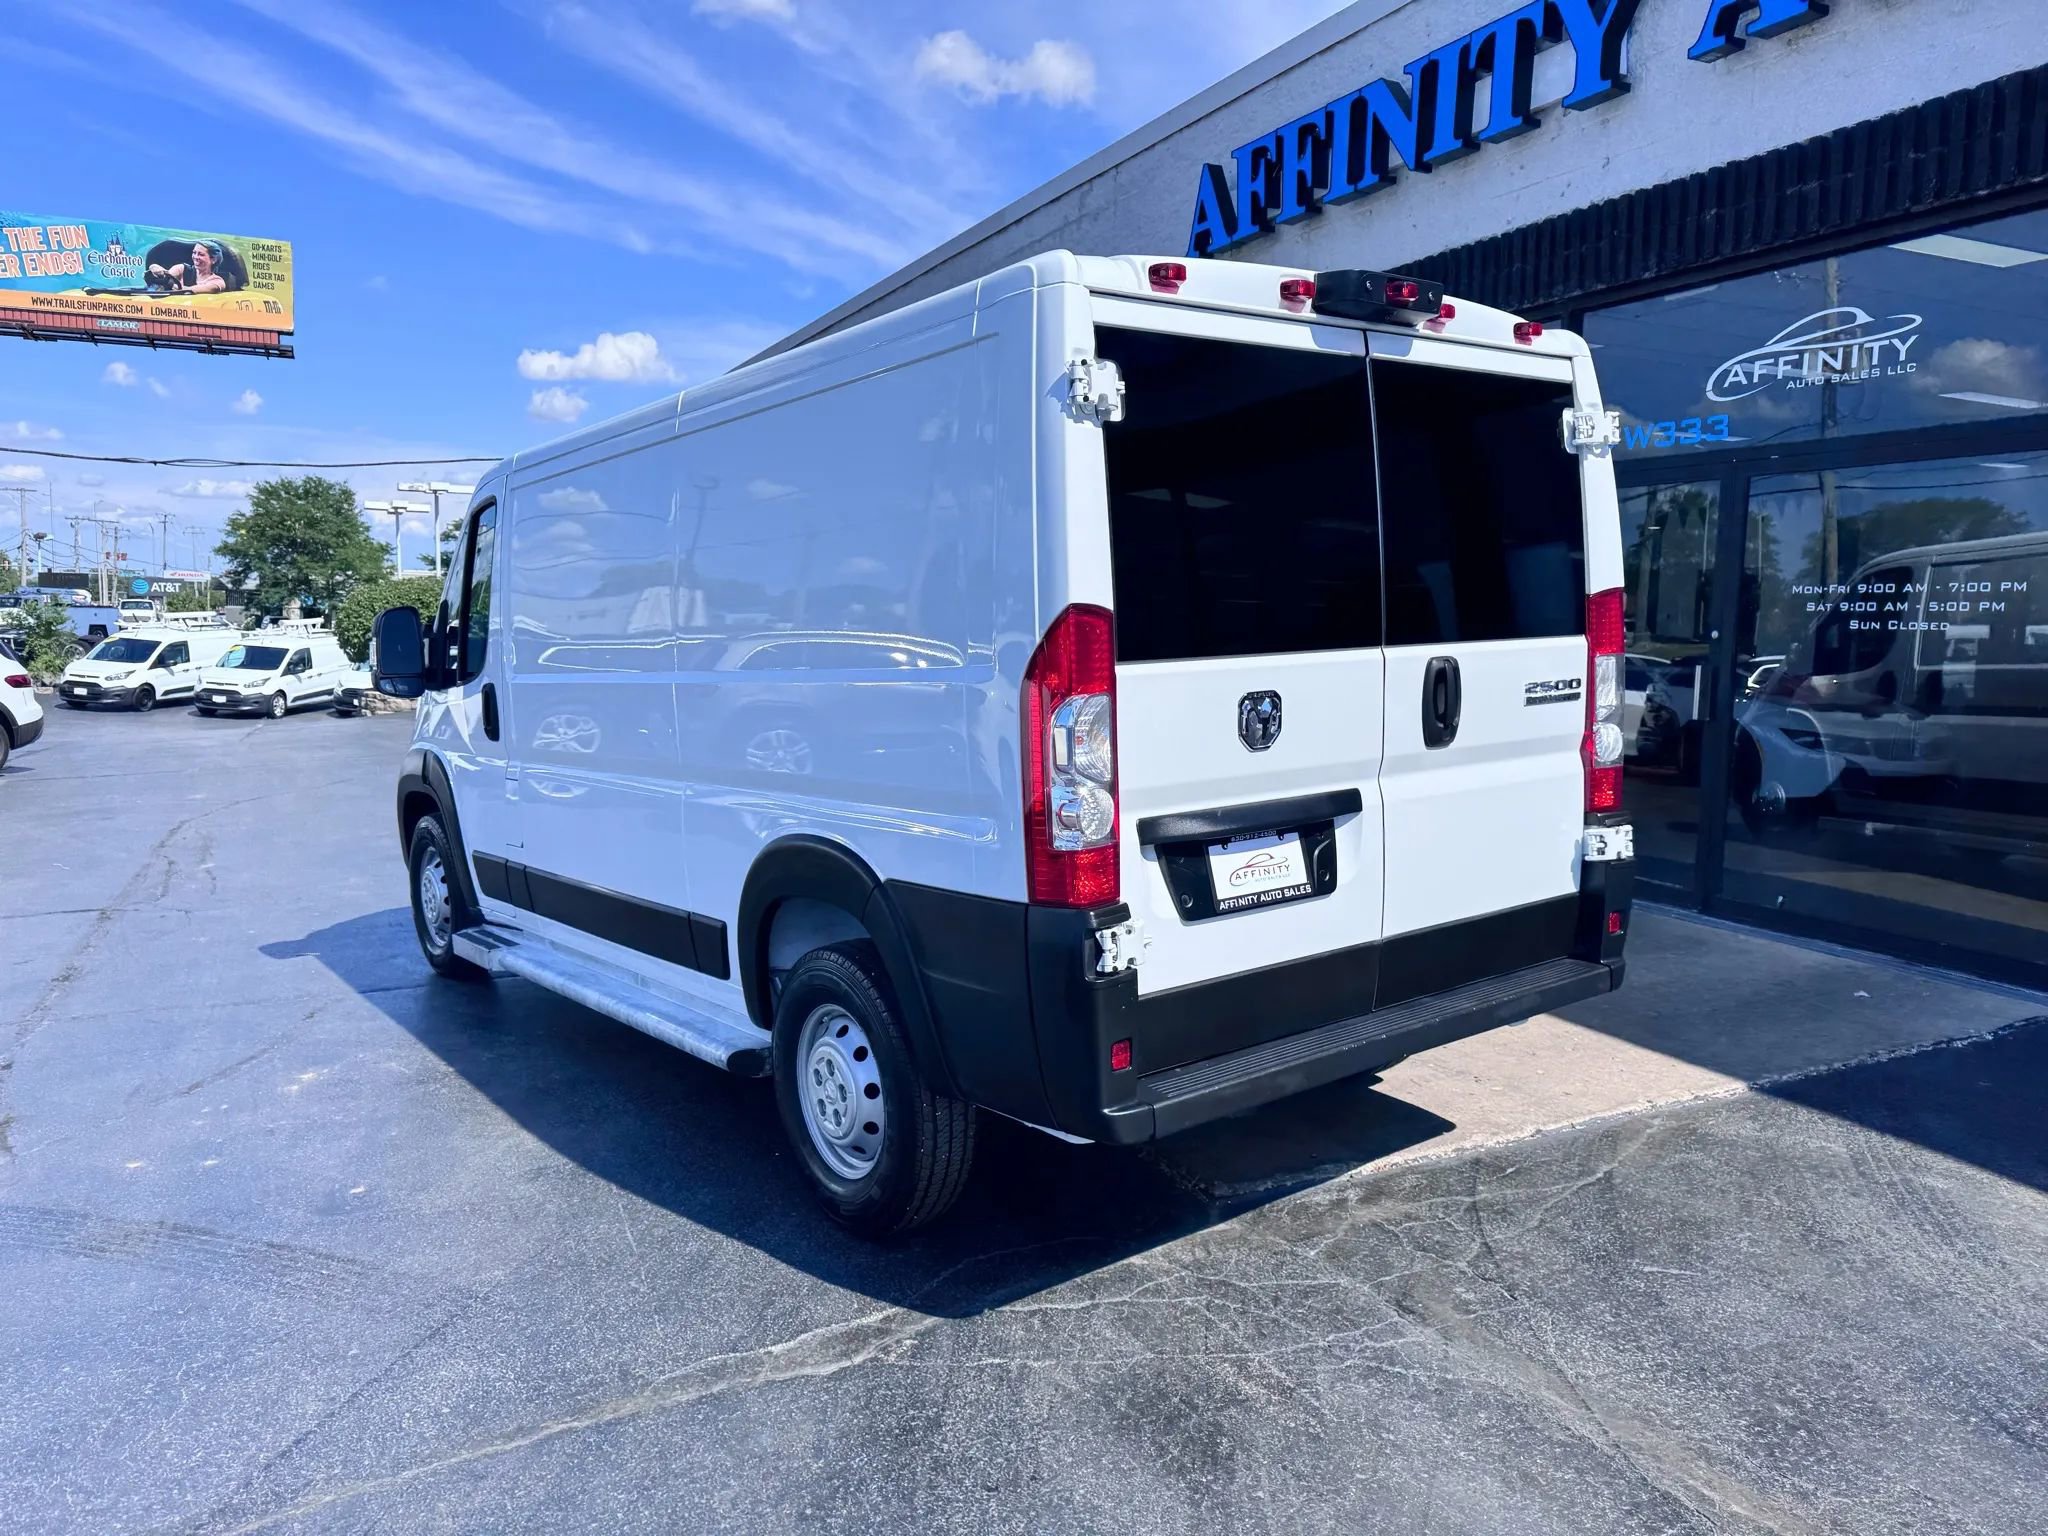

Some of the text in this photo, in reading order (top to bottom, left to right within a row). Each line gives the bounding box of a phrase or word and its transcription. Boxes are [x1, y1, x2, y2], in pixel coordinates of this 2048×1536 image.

[1187, 0, 1638, 257] AFFINITY
[3, 225, 90, 252] THE FUN
[251, 242, 282, 253] GO-KARTS
[22, 251, 85, 277] ENDS!
[87, 250, 144, 266] Enchanted
[251, 251, 283, 263] MINI-GOLF
[101, 265, 136, 278] Castle
[252, 261, 271, 271] RIDES
[252, 271, 285, 282] LASER TAG
[253, 280, 275, 291] GAMES
[31, 296, 143, 315] WWW.TRAILSFUNPARKS.COM
[100, 319, 136, 329] LAMAR
[1723, 334, 1920, 388] AFFINITY
[1786, 362, 1917, 390] AUTO SALES LLC
[1607, 414, 1729, 450] W333
[150, 582, 182, 593] AT&T
[1857, 583, 1896, 594] 9:00
[1902, 582, 1928, 593] AM
[1948, 582, 1991, 593] 7:00
[2000, 581, 2027, 593] PM
[1839, 601, 1877, 612] 9:00
[1883, 602, 1908, 612] AM
[1928, 601, 1970, 612] 5:00
[1979, 601, 2005, 612] PM
[1524, 678, 1581, 693] 2500
[1235, 864, 1290, 881] AFFINITY
[1219, 884, 1312, 910] AFFINITY AUTO SALES
